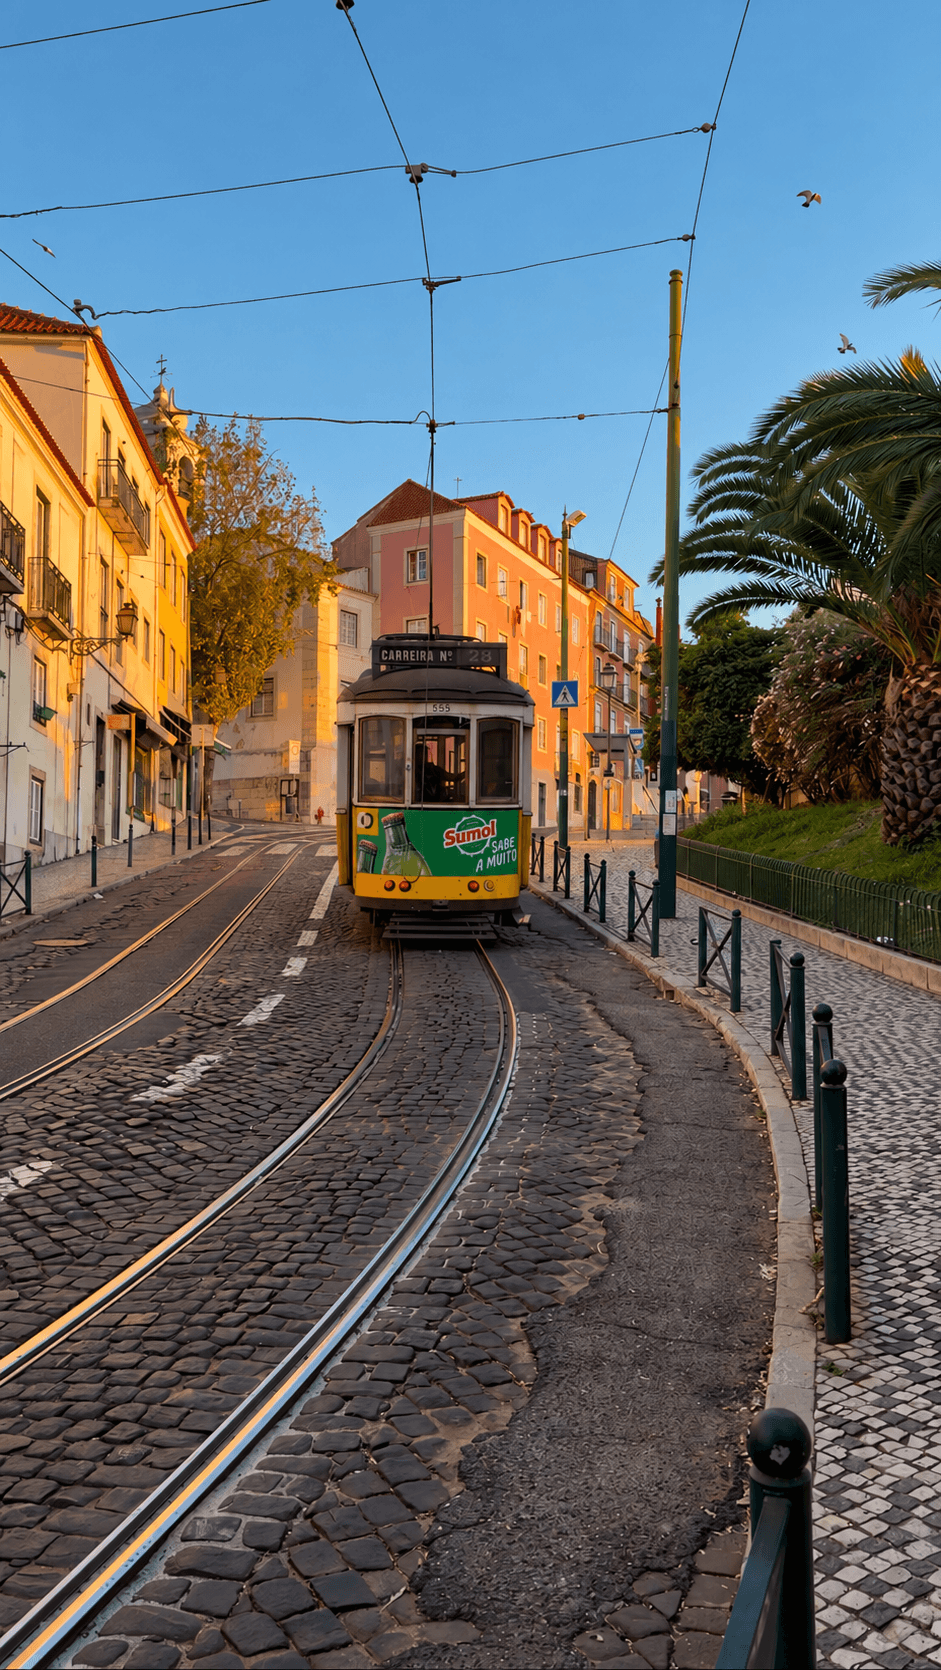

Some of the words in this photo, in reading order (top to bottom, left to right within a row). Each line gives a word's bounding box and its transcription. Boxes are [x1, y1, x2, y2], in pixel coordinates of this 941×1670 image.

[381, 650, 434, 661] CARREIRA
[469, 650, 492, 662] 28
[432, 704, 450, 712] 555
[443, 819, 497, 848] Sumol
[491, 837, 515, 853] SABE
[476, 859, 483, 873] A
[486, 849, 517, 869] MUITO
